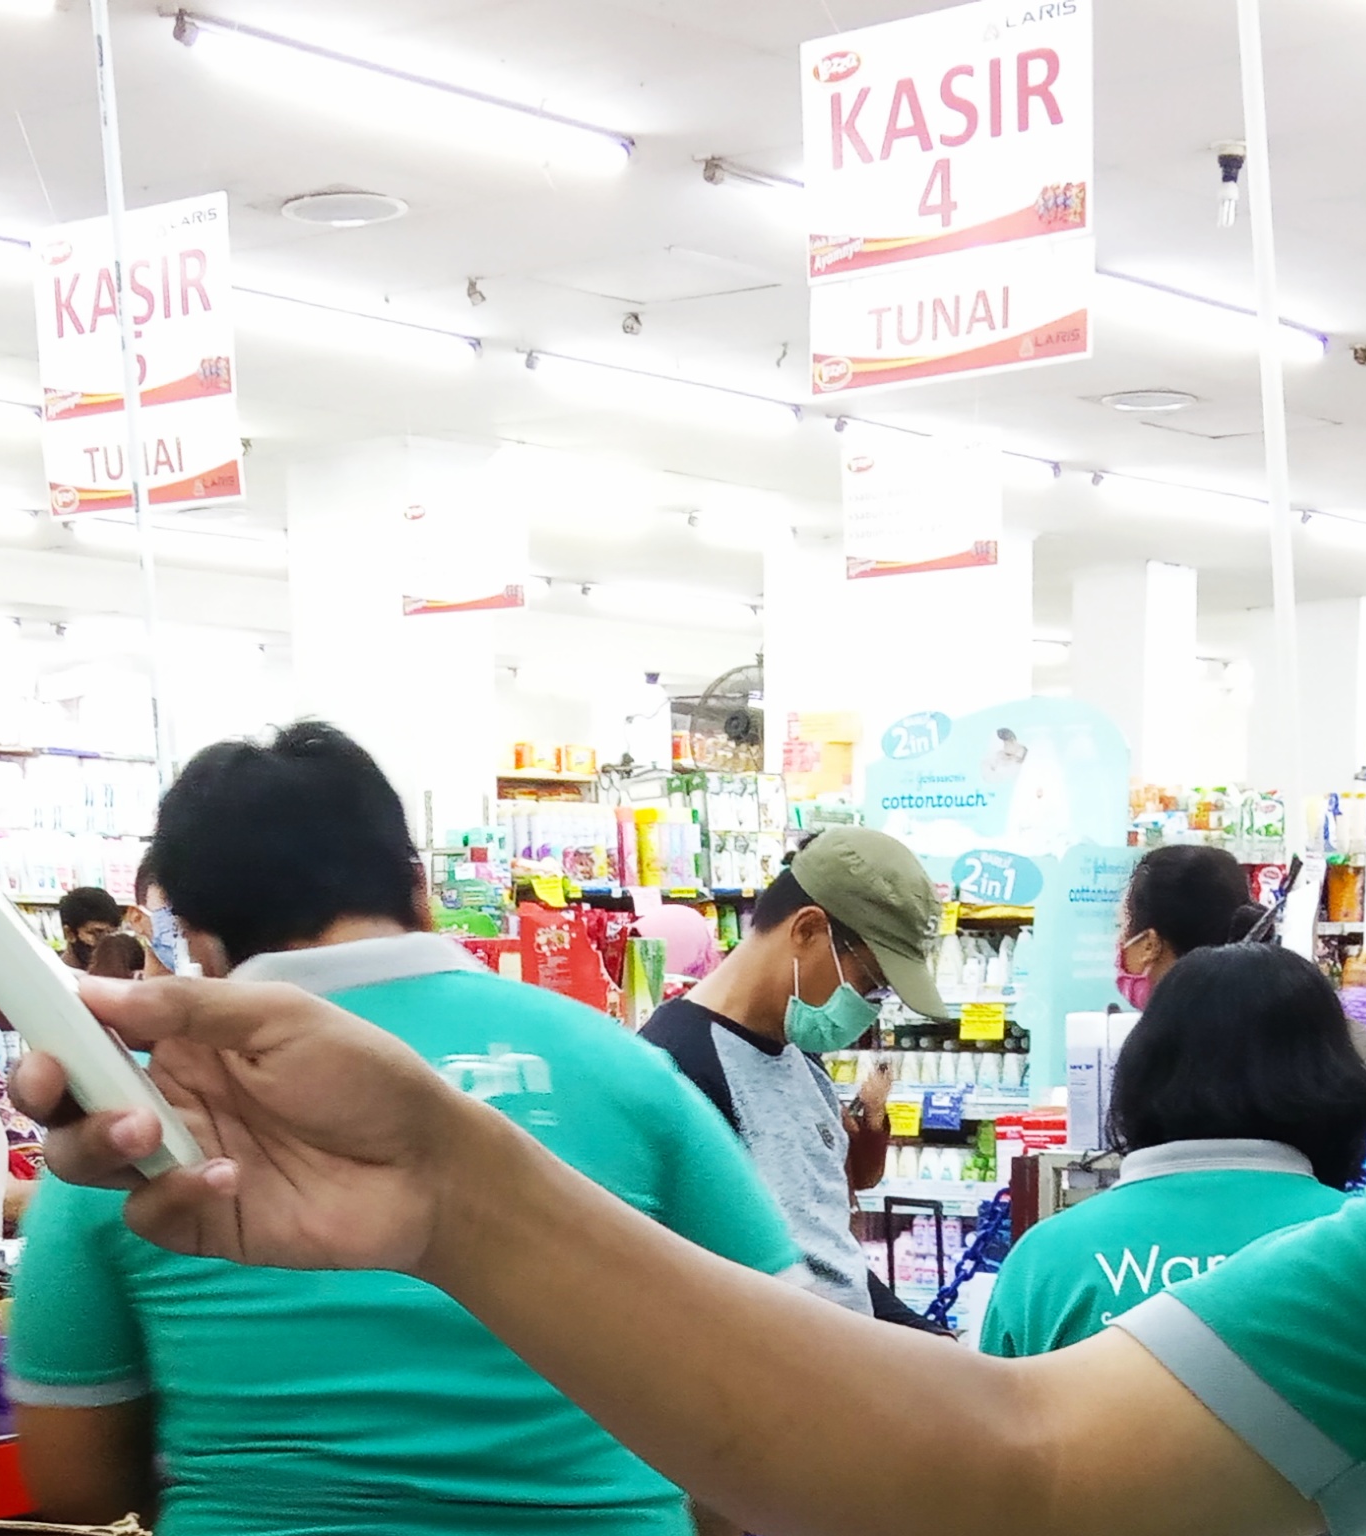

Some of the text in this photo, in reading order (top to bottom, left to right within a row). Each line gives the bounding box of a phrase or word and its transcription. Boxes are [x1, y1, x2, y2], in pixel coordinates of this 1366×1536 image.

[1005, 0, 1077, 28] LARIS
[830, 47, 1064, 170] KASIR
[918, 158, 957, 228] 4
[54, 248, 212, 339] KASIR
[868, 285, 1010, 350] TUNAI
[881, 789, 988, 811] cottontouch
